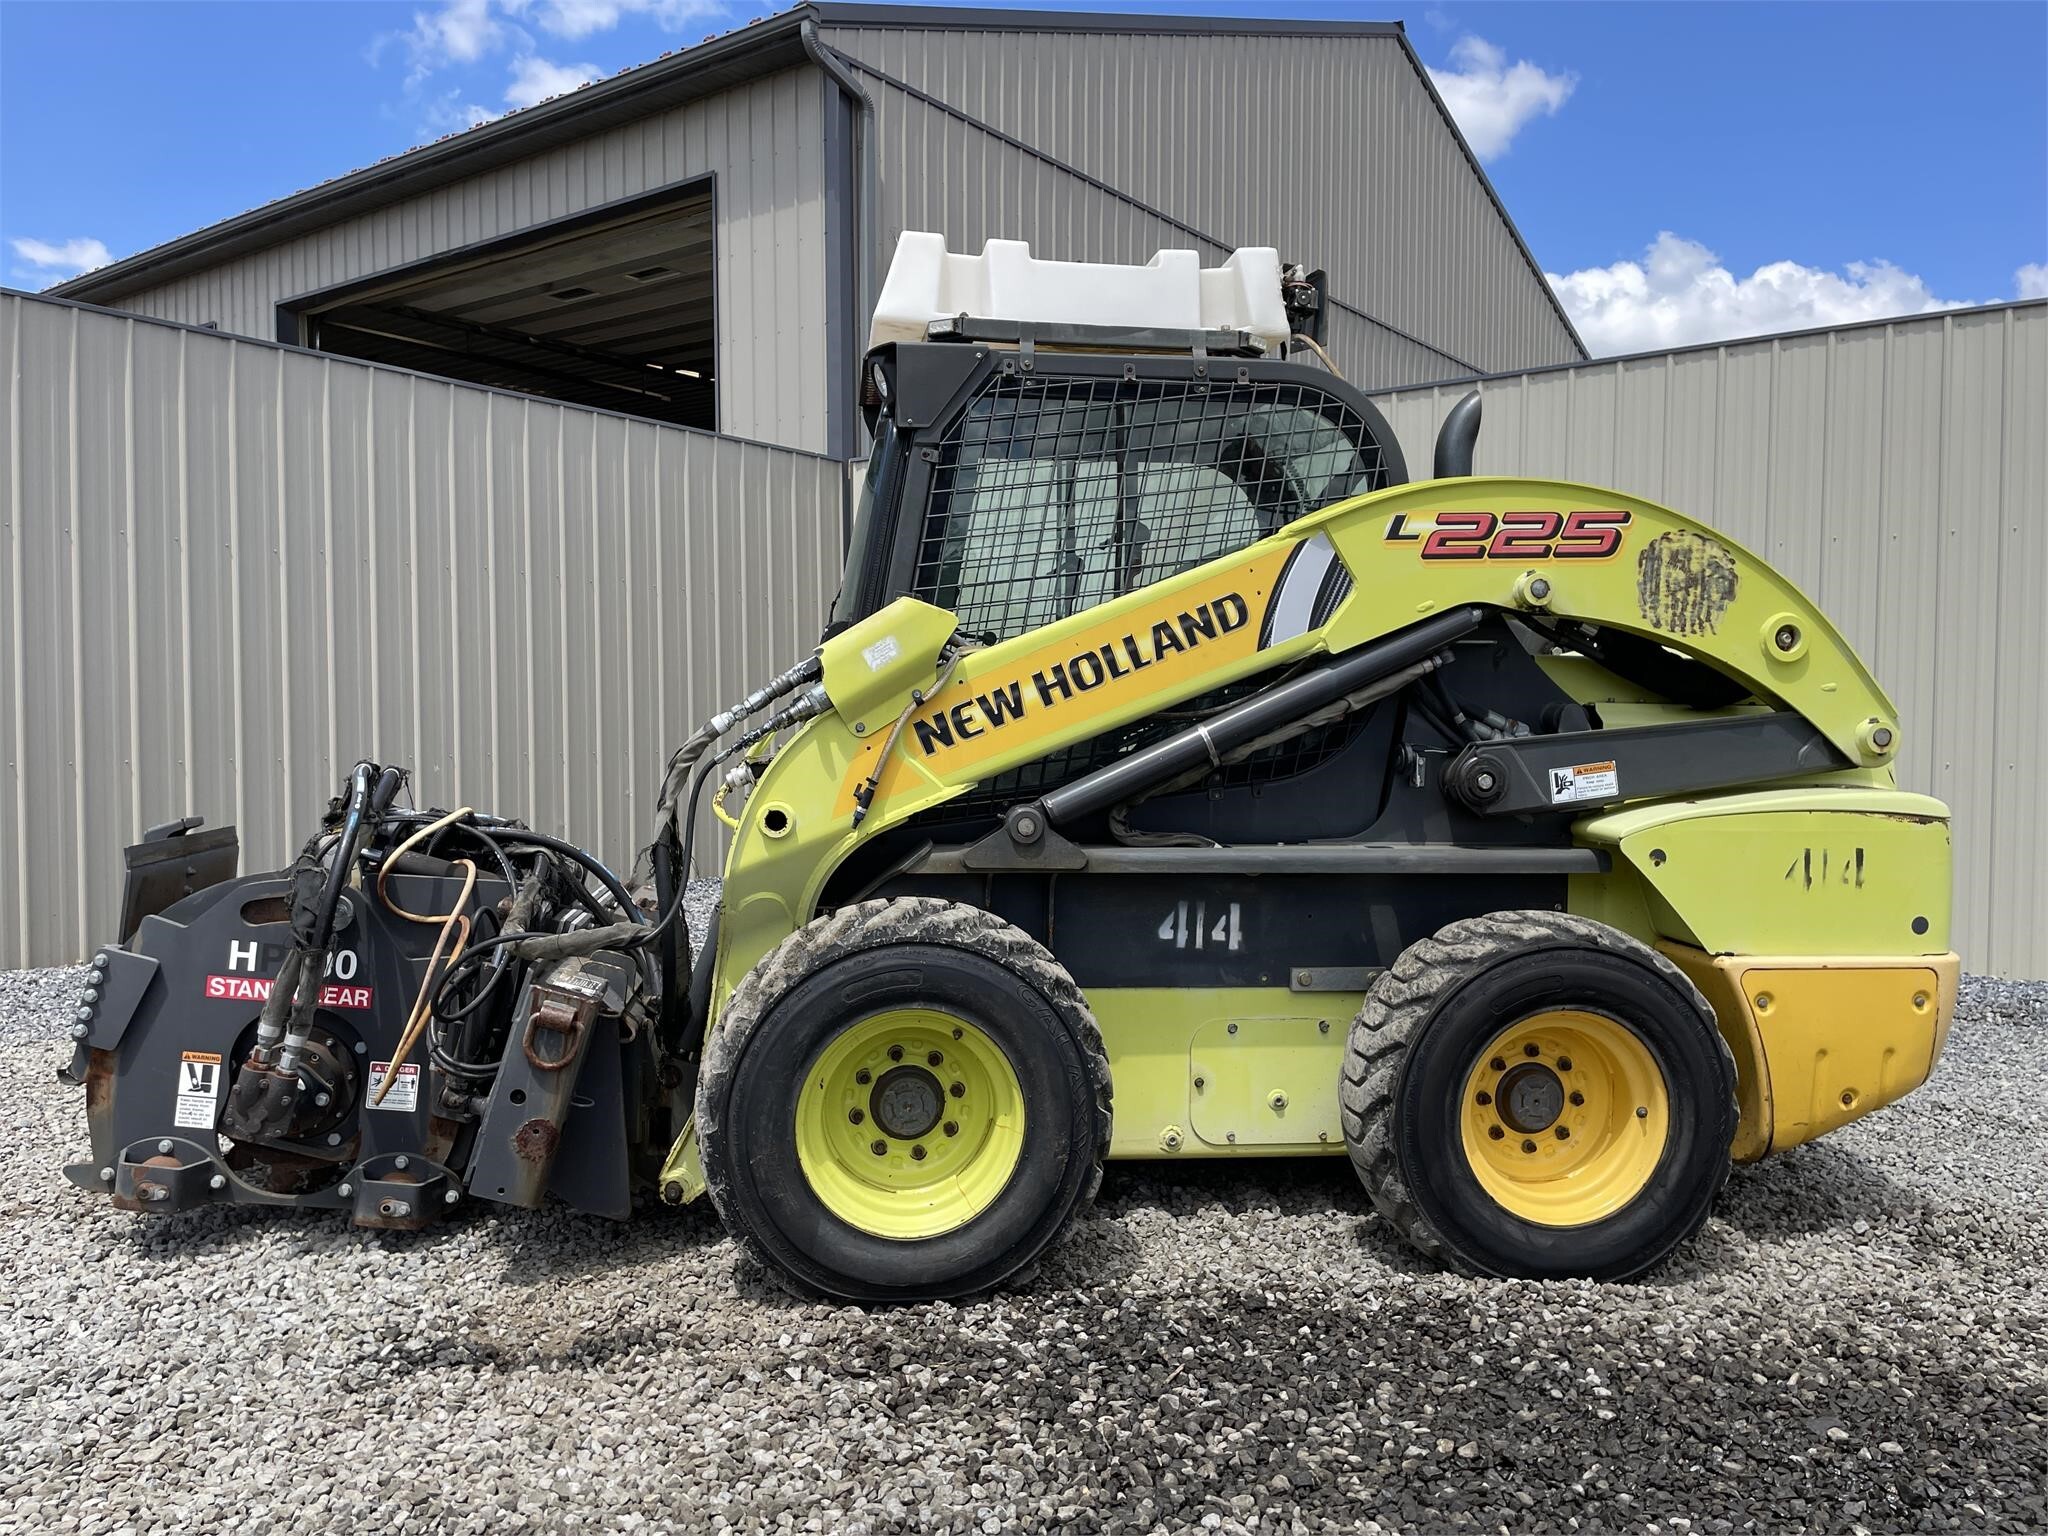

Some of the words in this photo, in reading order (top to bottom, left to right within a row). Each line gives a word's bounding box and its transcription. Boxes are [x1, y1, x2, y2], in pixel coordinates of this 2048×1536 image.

[912, 679, 1026, 757] NEW
[1031, 591, 1250, 708] HOLLAND
[1583, 764, 1612, 773] WARNING
[1158, 900, 1242, 950] 414
[209, 976, 276, 1000] STAN
[191, 1053, 220, 1063] WARNING
[384, 1065, 415, 1074] DGER
